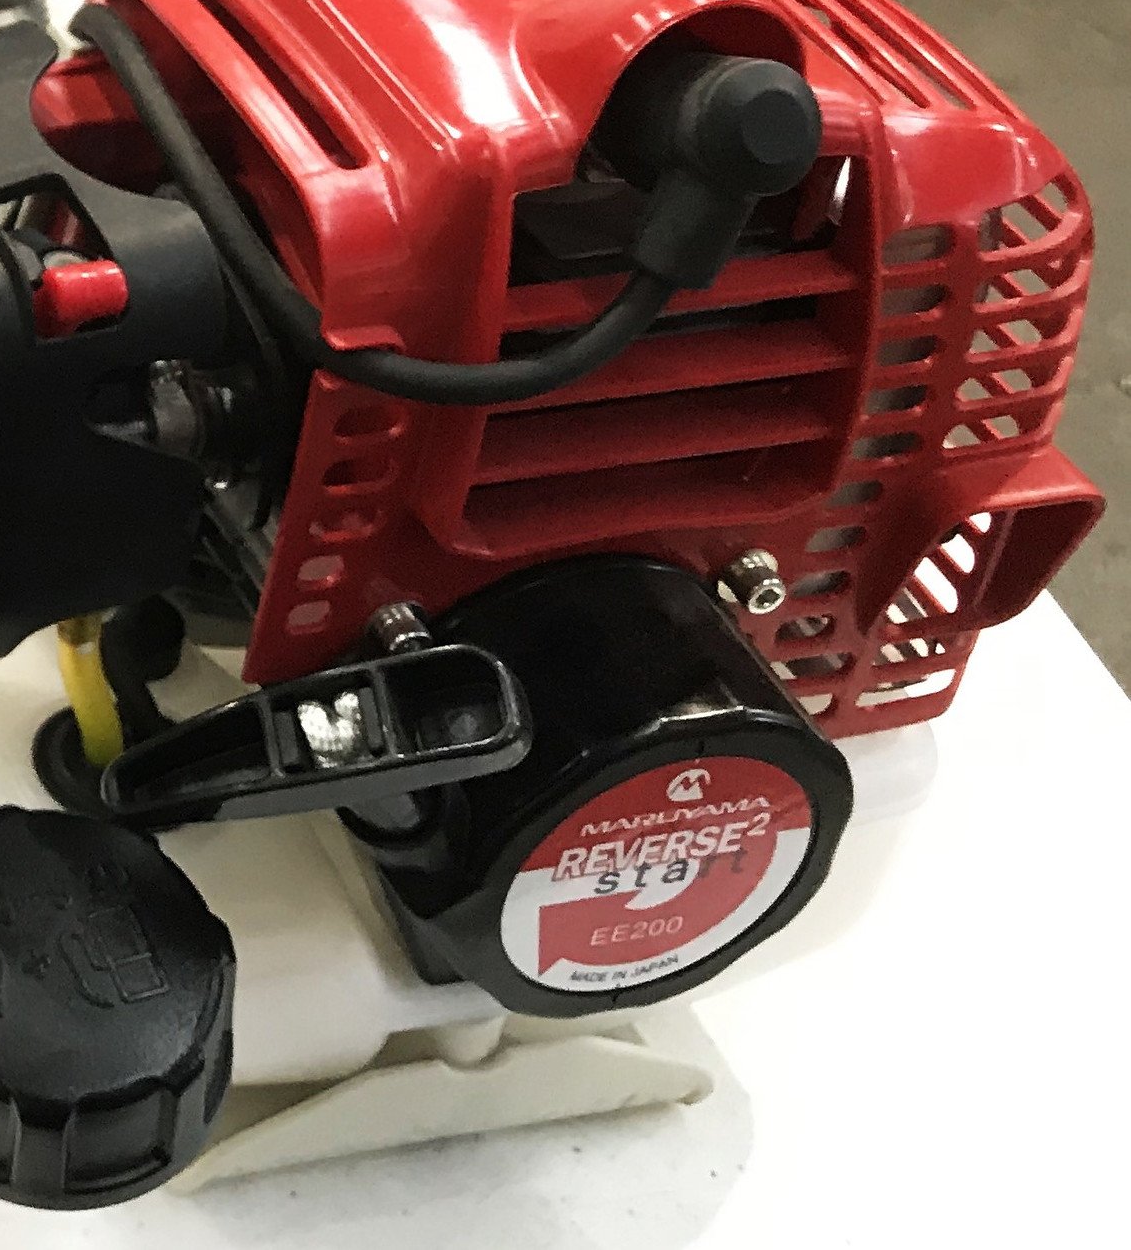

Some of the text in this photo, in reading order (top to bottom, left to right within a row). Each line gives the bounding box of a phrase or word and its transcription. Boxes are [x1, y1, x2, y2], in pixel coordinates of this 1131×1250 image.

[580, 796, 771, 837] MARUYAMA
[594, 848, 745, 895] start
[590, 915, 684, 947] EE200
[570, 953, 679, 982] MADE IN JAPAN
